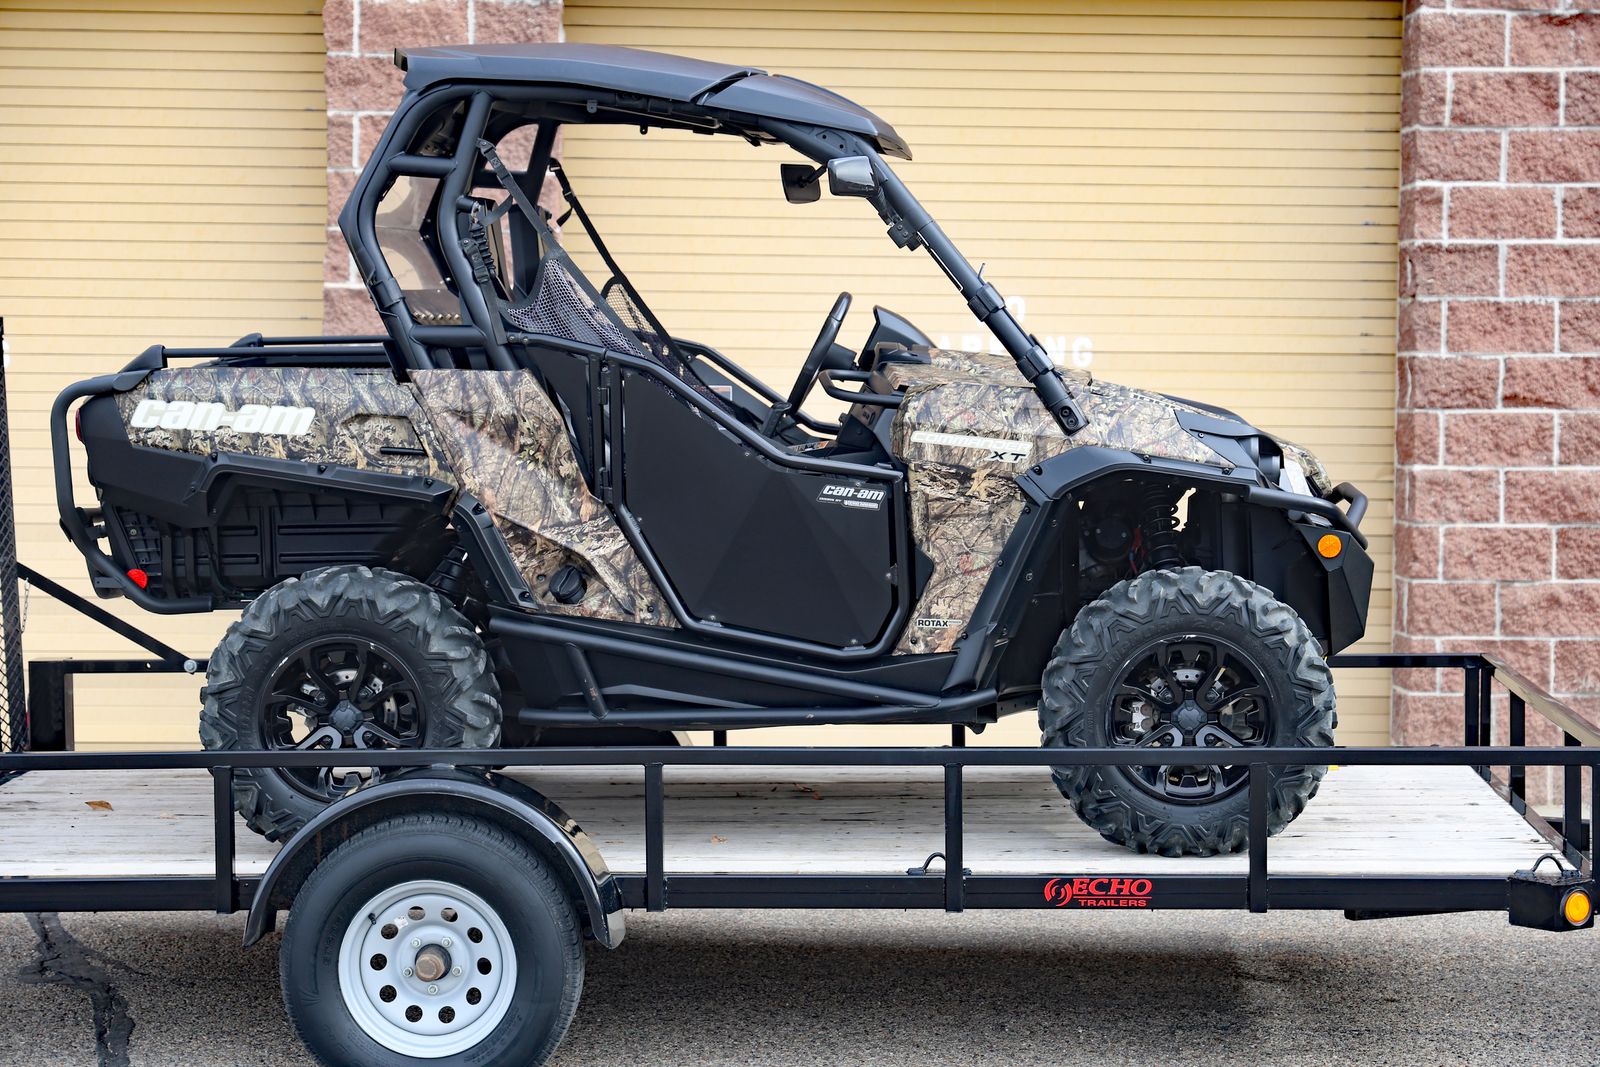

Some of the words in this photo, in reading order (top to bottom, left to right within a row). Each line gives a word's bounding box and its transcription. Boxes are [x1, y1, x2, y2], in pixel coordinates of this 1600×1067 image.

[131, 400, 316, 435] can-am
[990, 451, 1026, 461] XT
[822, 485, 884, 501] can-am
[917, 619, 949, 627] ROTAX
[1072, 878, 1153, 896] ECHO
[1078, 899, 1147, 907] TRAILERS
